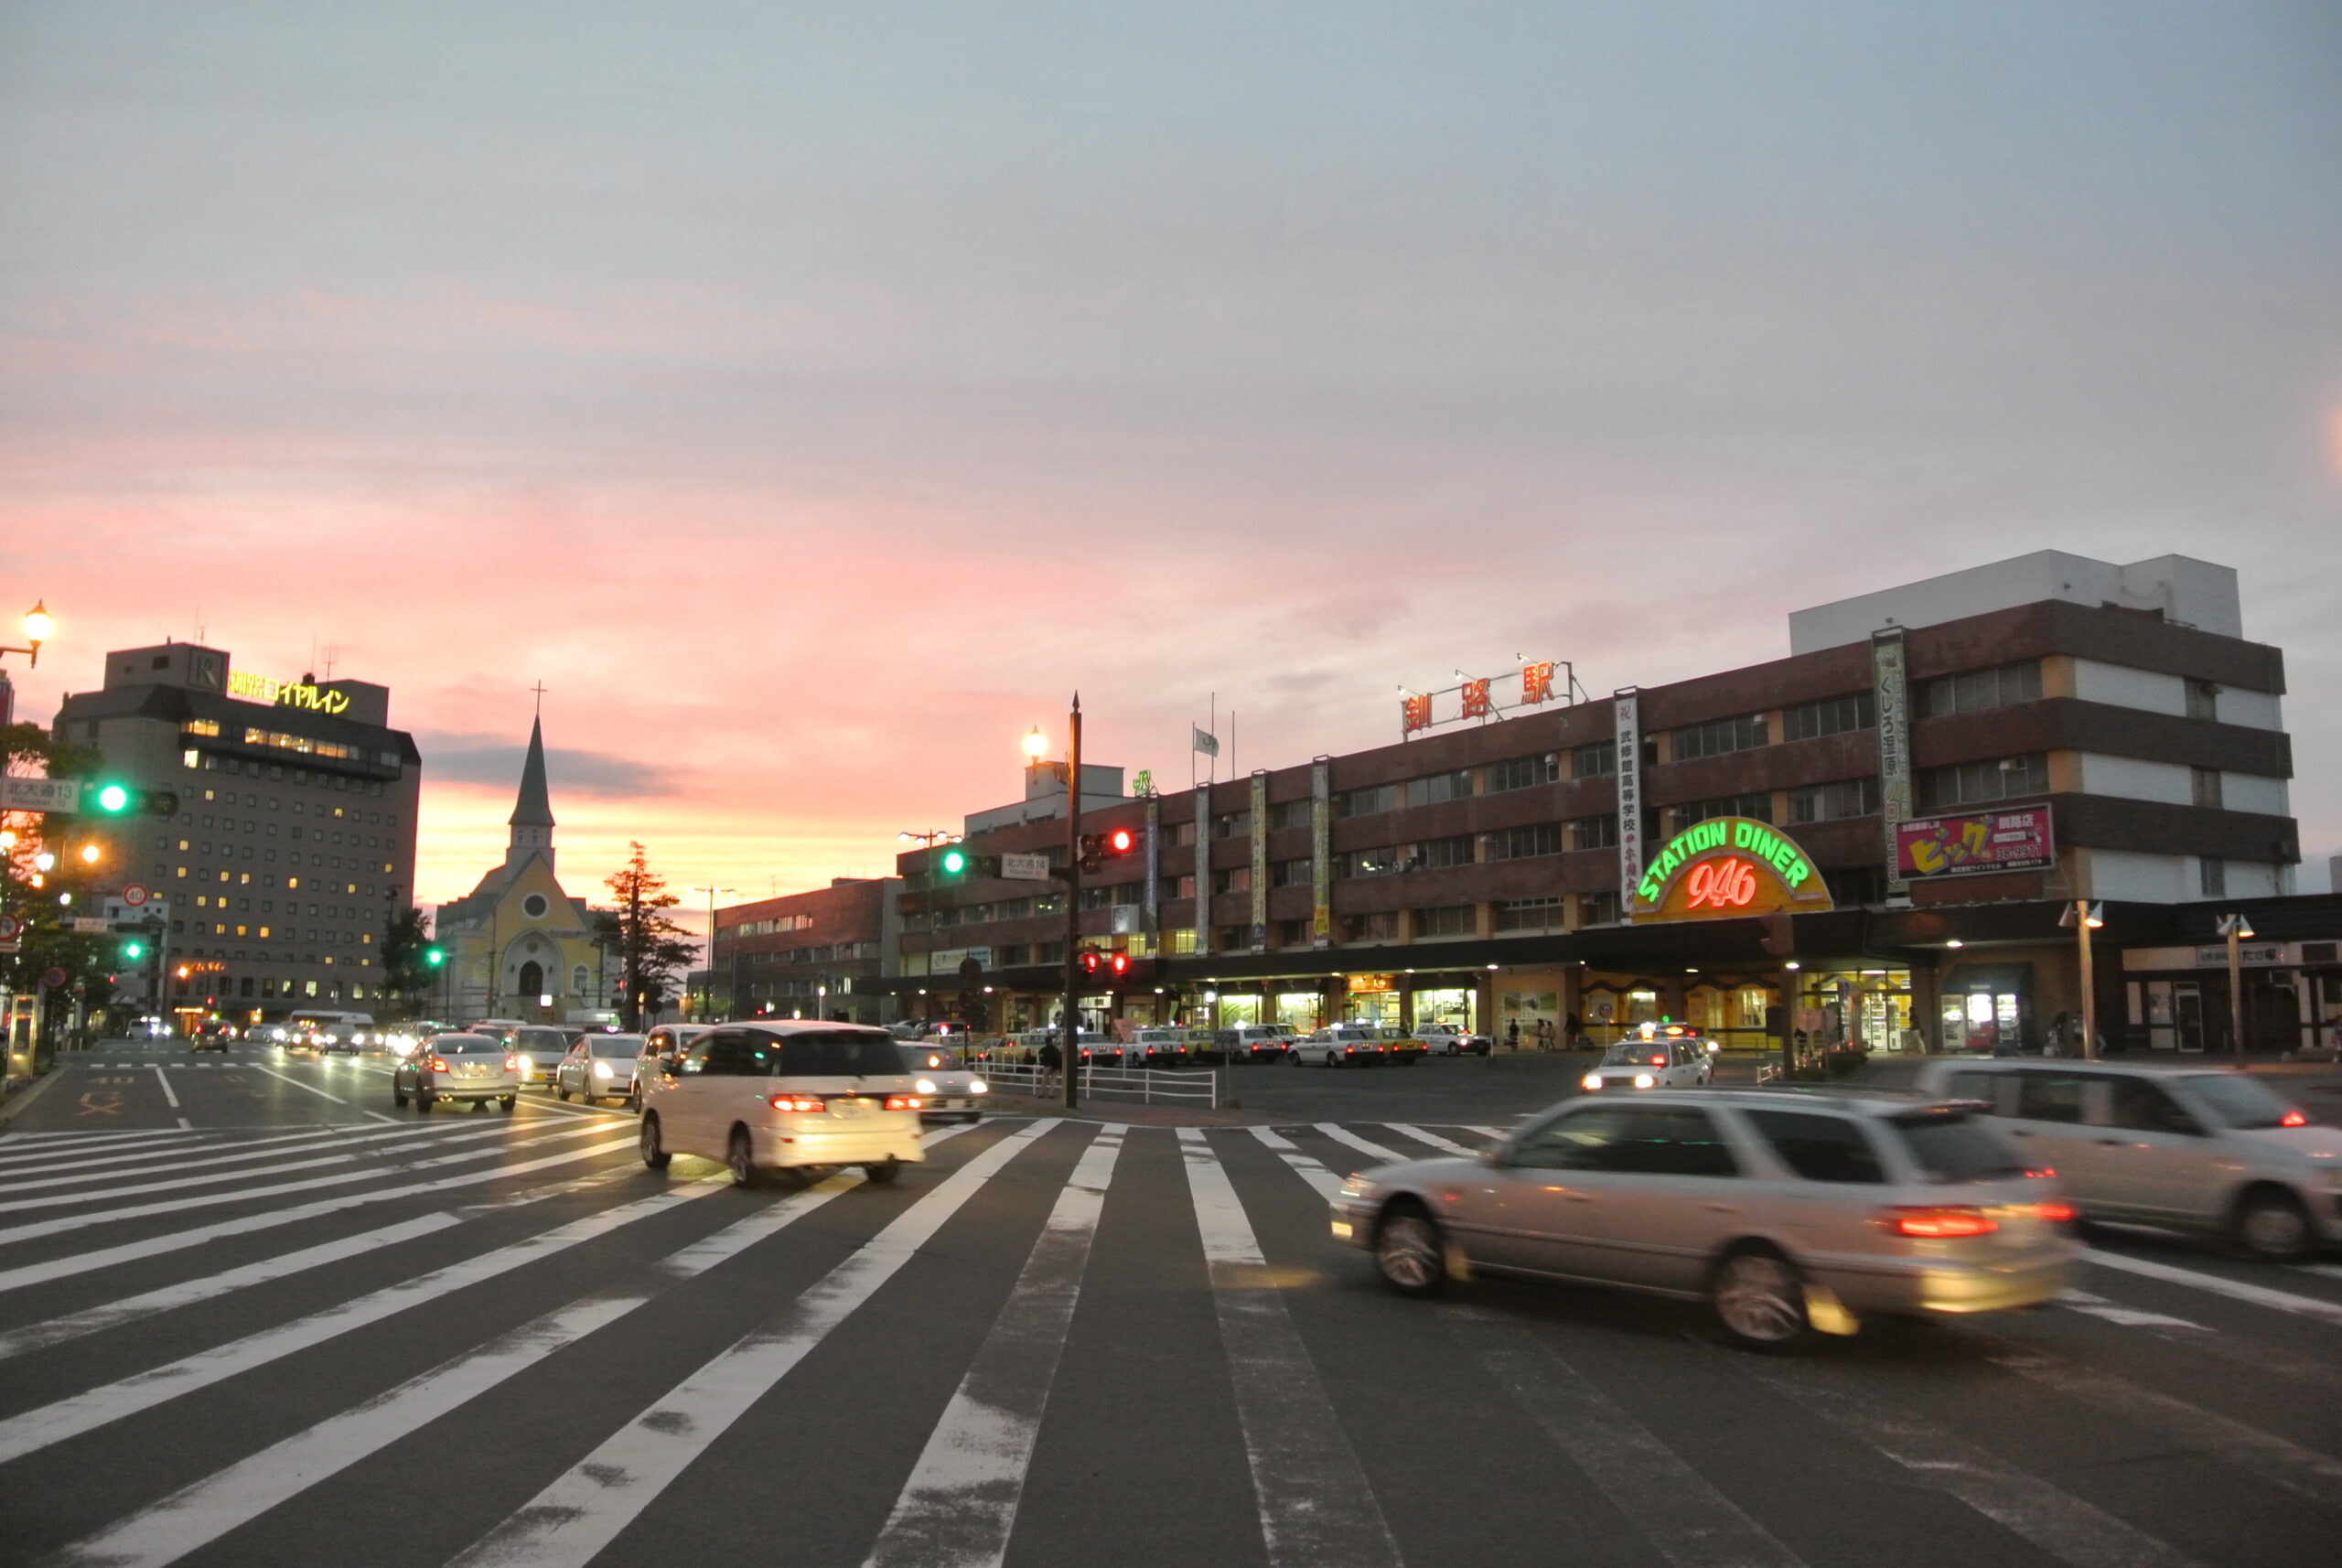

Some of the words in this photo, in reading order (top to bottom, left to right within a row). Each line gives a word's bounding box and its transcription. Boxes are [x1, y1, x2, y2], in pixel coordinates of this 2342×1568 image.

[229, 671, 349, 714] 釧路ロイヤルイン
[1404, 660, 1554, 733] 釧路駅
[8, 782, 73, 799] 北大通13
[1133, 770, 1151, 789] JR
[1620, 730, 1636, 832] 武修館高等学校
[1908, 813, 1994, 875] ビッグ
[1998, 813, 2035, 830] 釧路店
[1638, 821, 1727, 903] STATION
[1735, 822, 1810, 889] DINER
[1687, 856, 1756, 908] 946
[128, 890, 143, 903] 40
